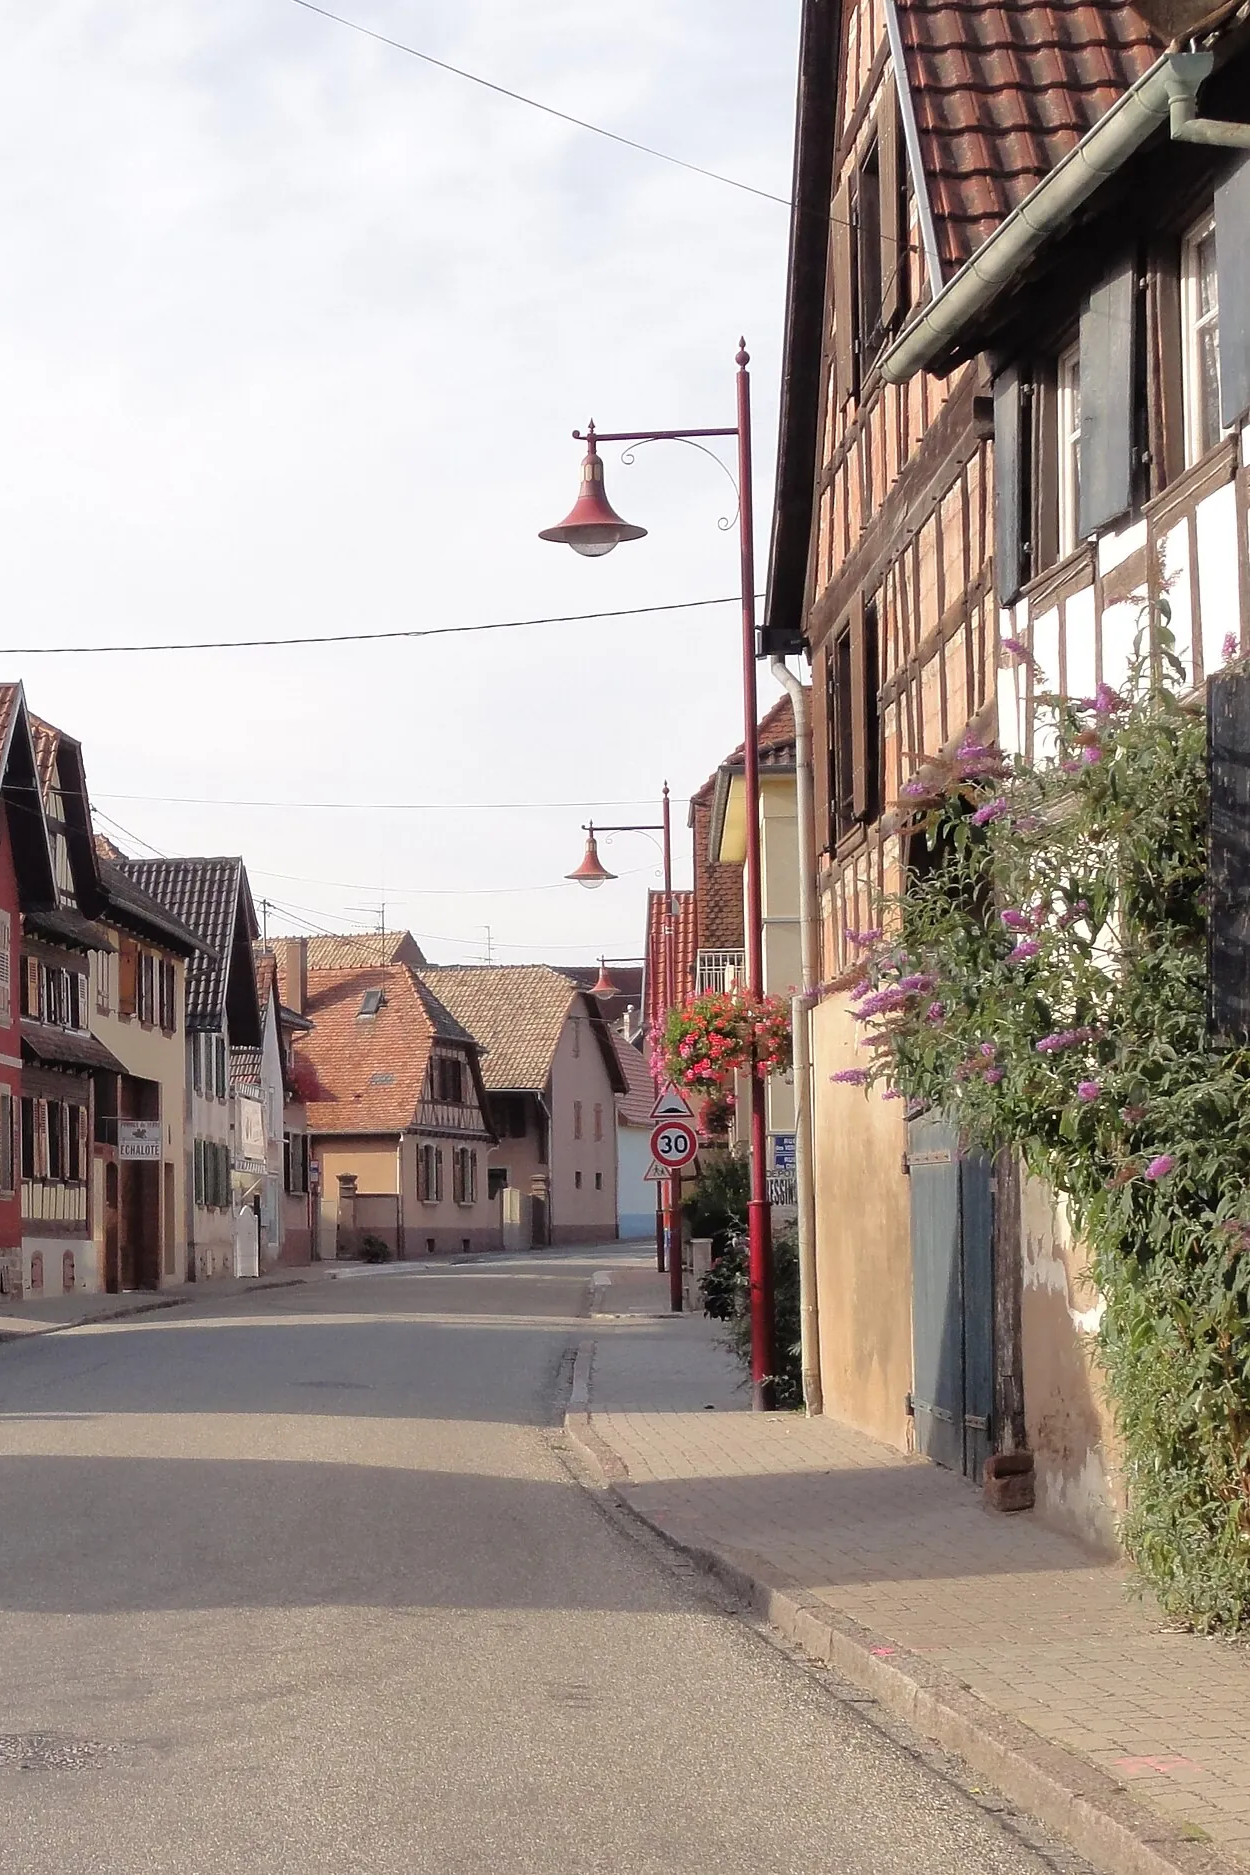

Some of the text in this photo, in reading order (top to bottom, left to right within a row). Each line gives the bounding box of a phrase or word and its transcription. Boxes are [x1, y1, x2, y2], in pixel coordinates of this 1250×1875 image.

[120, 1144, 159, 1155] ECHALOTE
[659, 1134, 688, 1154] 30
[765, 1169, 796, 1178] DEPOT
